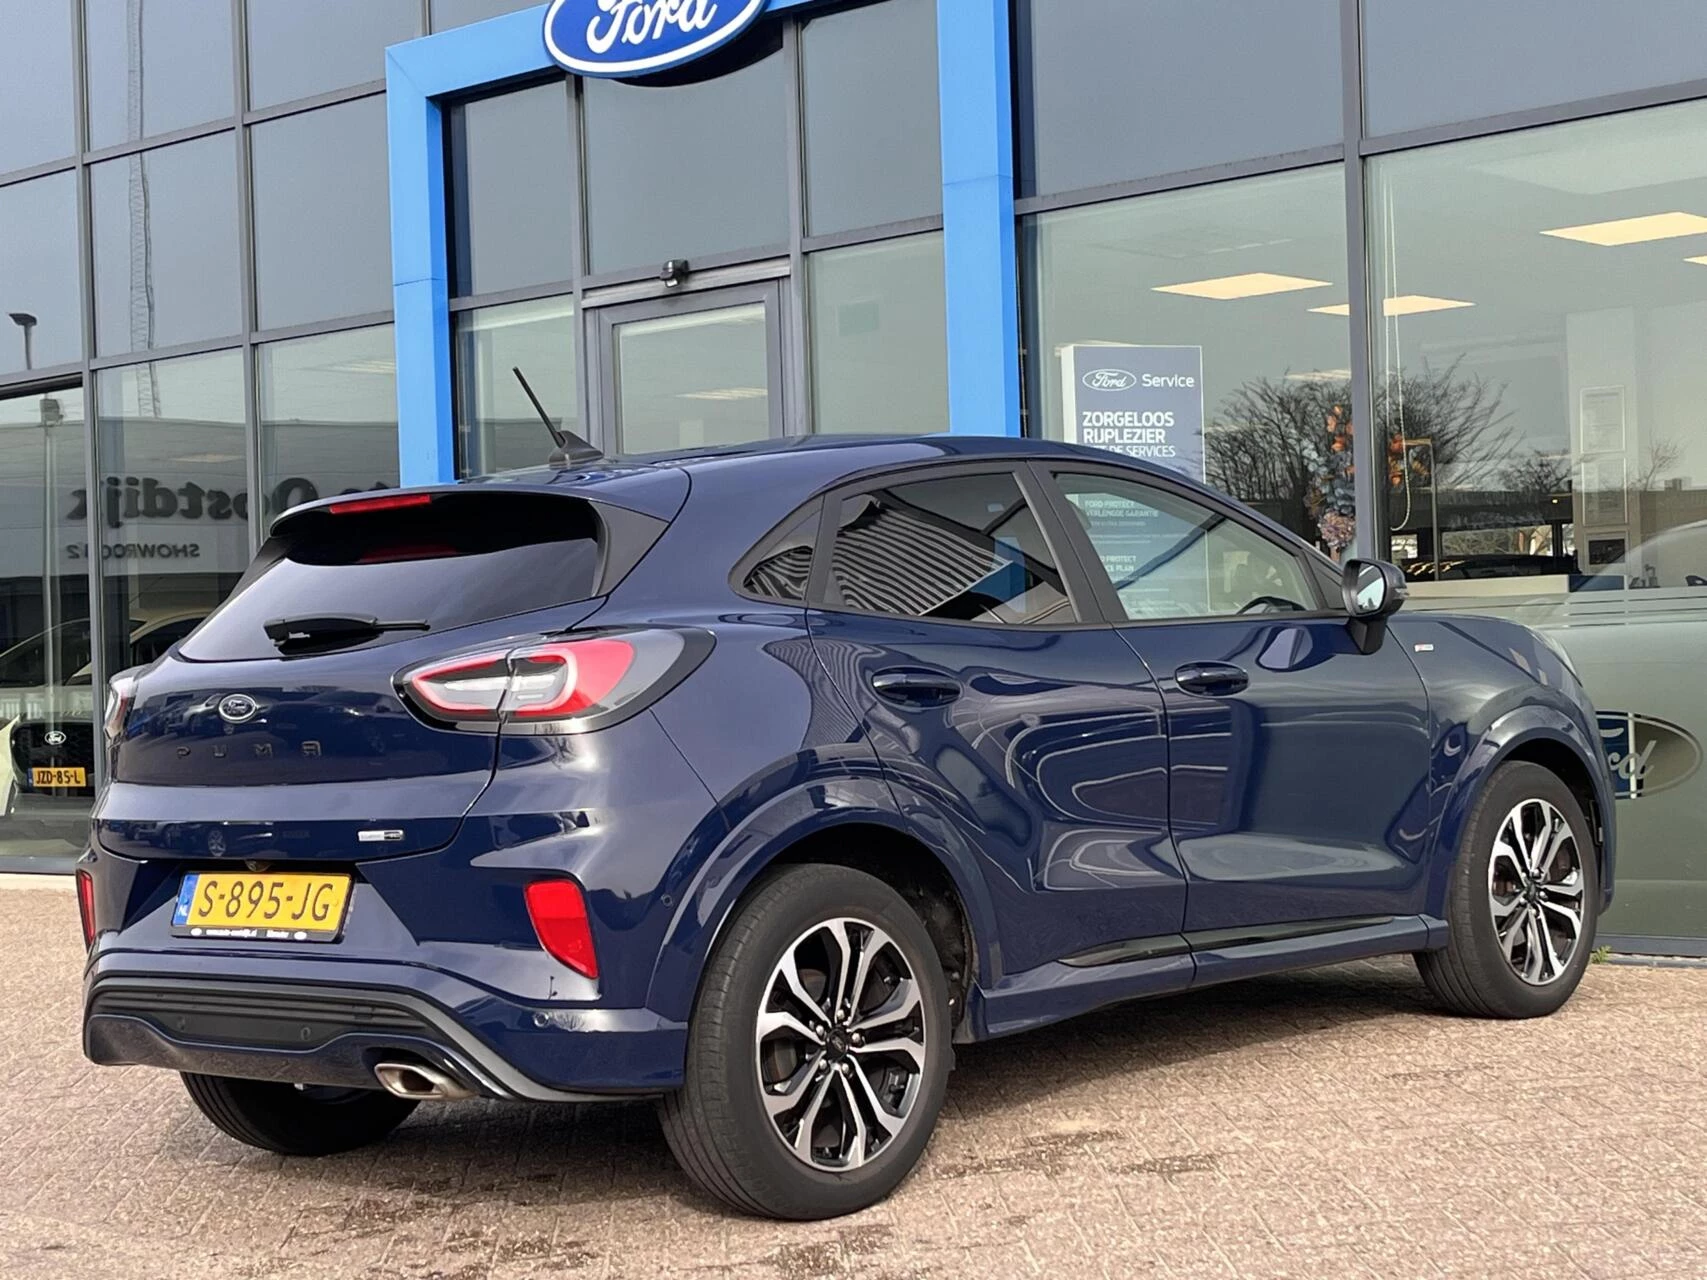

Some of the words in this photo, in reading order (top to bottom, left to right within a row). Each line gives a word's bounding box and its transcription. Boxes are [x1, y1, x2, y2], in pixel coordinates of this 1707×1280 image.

[1092, 371, 1127, 388] Ford
[1142, 374, 1195, 388] Service
[1082, 411, 1175, 427] ZORGELOOS
[1083, 428, 1166, 443] RIJPLEZIER
[1126, 445, 1176, 458] SERVICES
[176, 740, 322, 759] PUMA
[36, 770, 81, 785] JZD-85-L
[198, 880, 334, 921] S-895-JG
